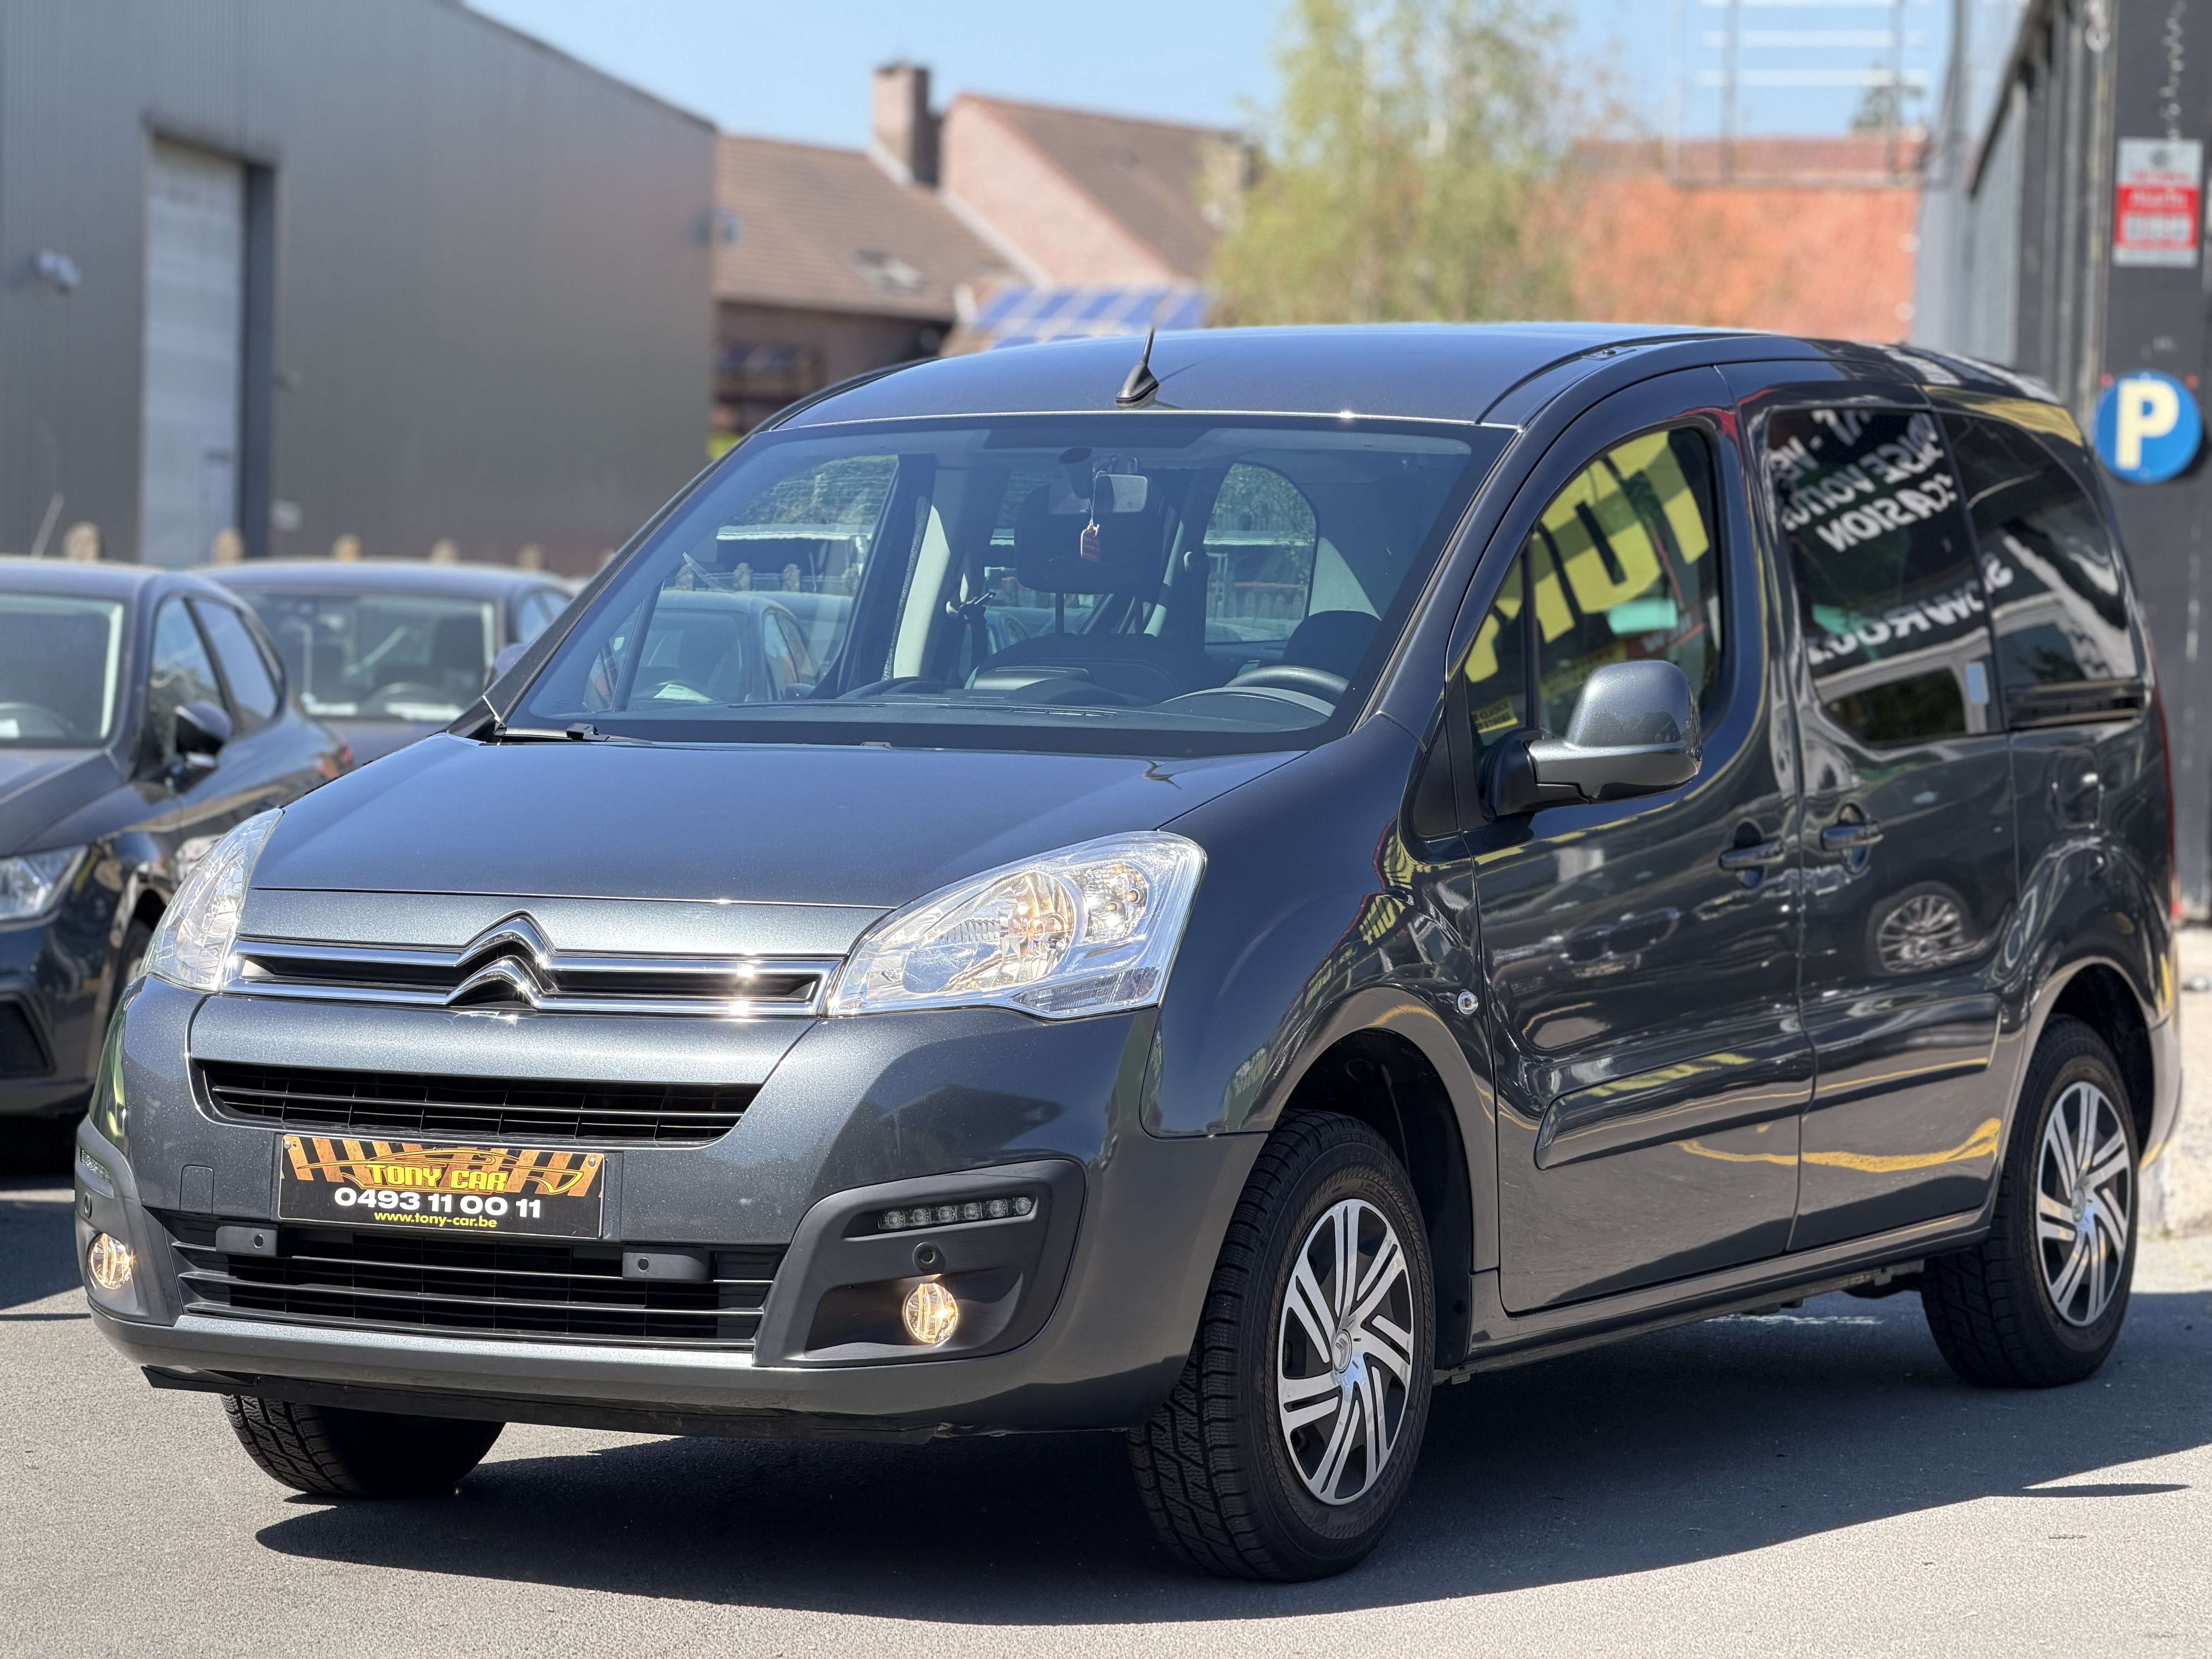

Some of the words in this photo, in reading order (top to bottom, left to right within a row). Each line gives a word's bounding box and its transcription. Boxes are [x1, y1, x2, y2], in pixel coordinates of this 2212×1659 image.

[2116, 379, 2179, 471] P
[366, 1164, 442, 1187] TONY
[451, 1169, 508, 1192] CAR
[334, 1187, 421, 1211] 0493
[428, 1193, 452, 1213] 11
[460, 1195, 508, 1217] 00
[515, 1198, 541, 1218] 11
[374, 1211, 498, 1228] www.tony-car.be
